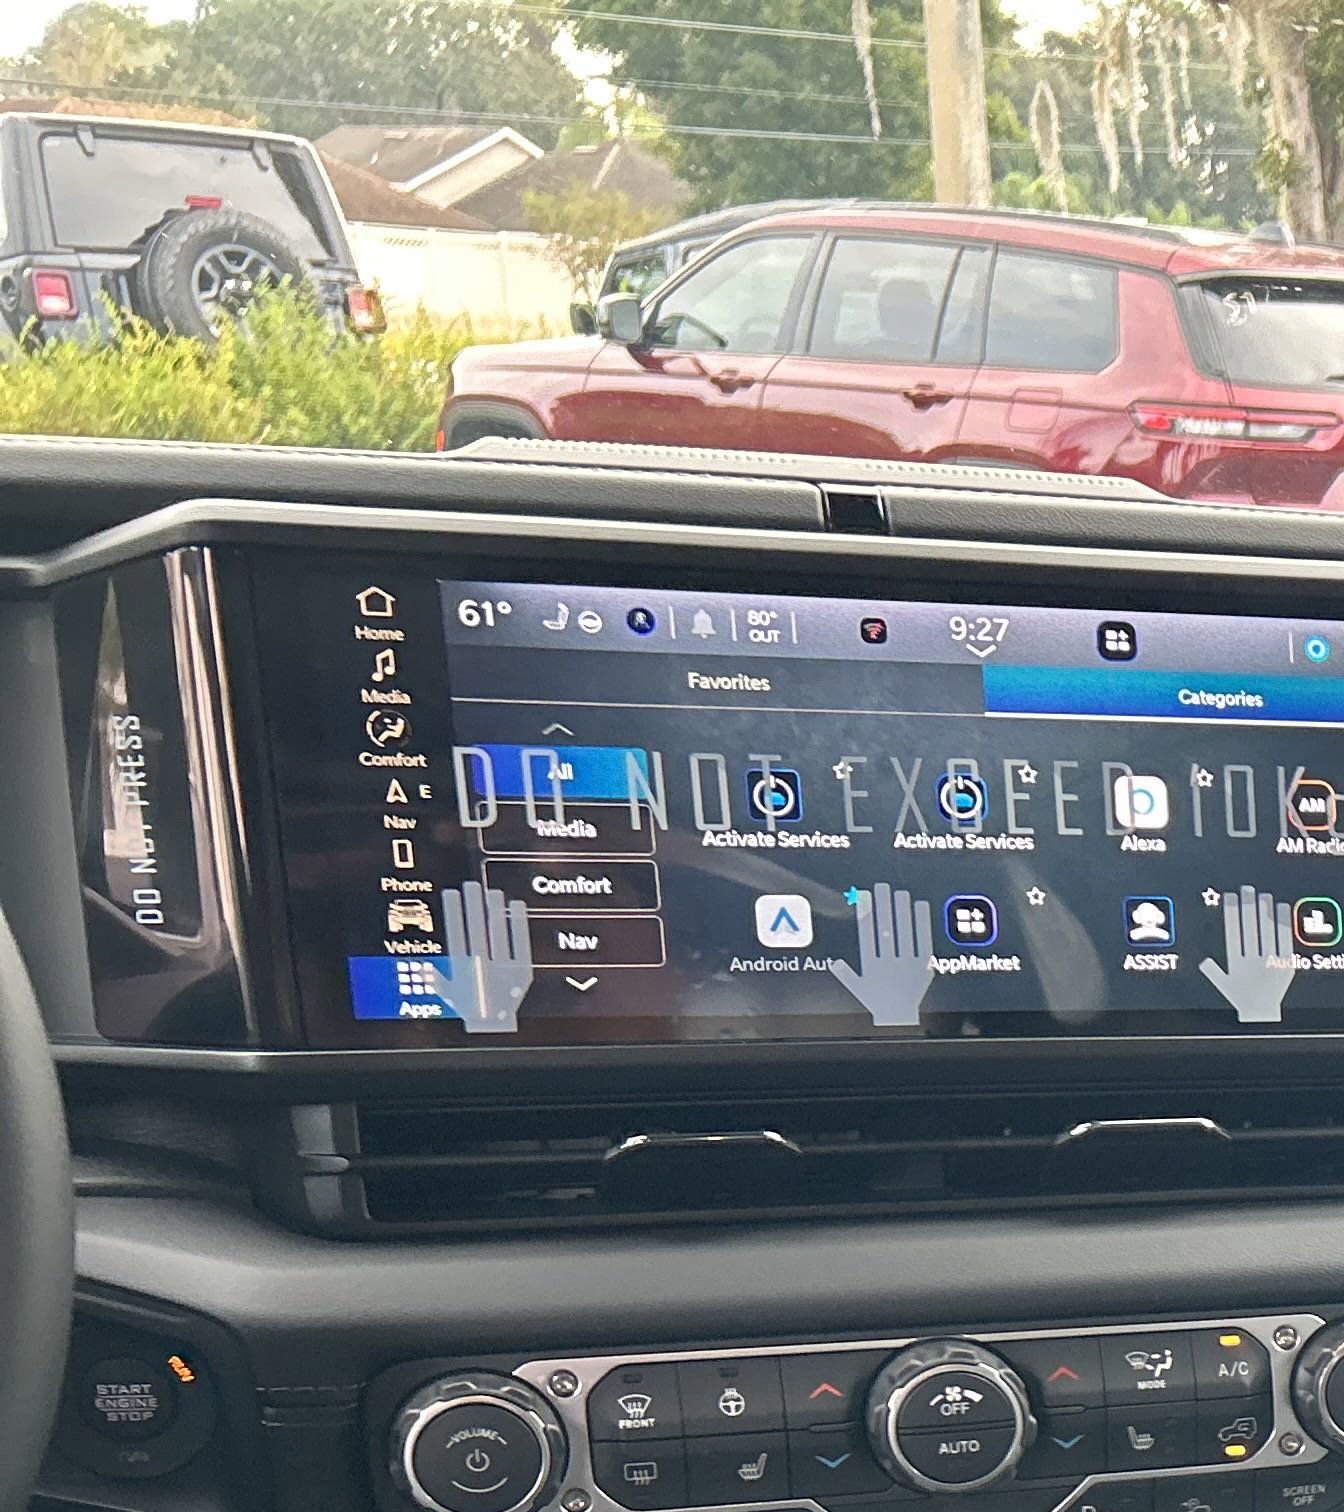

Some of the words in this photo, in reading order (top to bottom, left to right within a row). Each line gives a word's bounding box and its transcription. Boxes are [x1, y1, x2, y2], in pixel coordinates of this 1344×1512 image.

[354, 625, 405, 642] Home
[748, 629, 781, 644] OUT
[948, 615, 1010, 642] 9:27
[687, 671, 772, 692] Favorites
[360, 688, 413, 705] Media
[1177, 687, 1265, 710] Categories
[112, 713, 151, 807] PRESS
[358, 751, 429, 769] Comfort
[547, 762, 575, 781] All
[418, 783, 433, 799] E
[451, 745, 567, 830] DO
[624, 749, 783, 832] NOT
[840, 755, 1136, 837] EXCEED
[383, 814, 418, 831] Nav
[536, 818, 599, 840] Media
[701, 829, 777, 848] Activate
[777, 830, 851, 849] Services
[893, 832, 964, 850] Activate
[965, 833, 1035, 851] Services
[1120, 834, 1168, 852] Alexa
[1276, 838, 1306, 854] AM
[380, 877, 434, 893] Phone
[532, 875, 614, 896] Comfort
[132, 888, 165, 925] DO
[383, 939, 443, 955] Vehicle
[557, 931, 600, 951] Nav
[729, 955, 791, 973] Android
[794, 957, 838, 973] Aut
[926, 954, 1021, 974] AppMarket
[1122, 953, 1179, 971] ASSIST
[1265, 953, 1311, 970] Audio
[398, 1001, 443, 1019] Apps
[1217, 1360, 1250, 1378] A/C
[95, 1383, 153, 1395] START
[1136, 1378, 1167, 1391] MODE
[93, 1397, 160, 1409] ENGINE
[939, 1401, 971, 1417] OFF
[106, 1411, 155, 1422] STOP
[617, 1417, 657, 1431] FRONT
[450, 1426, 500, 1444] VOLUME
[938, 1439, 981, 1456] AUTO
[1281, 1483, 1327, 1498] SCREEN
[1292, 1495, 1315, 1508] OFF
